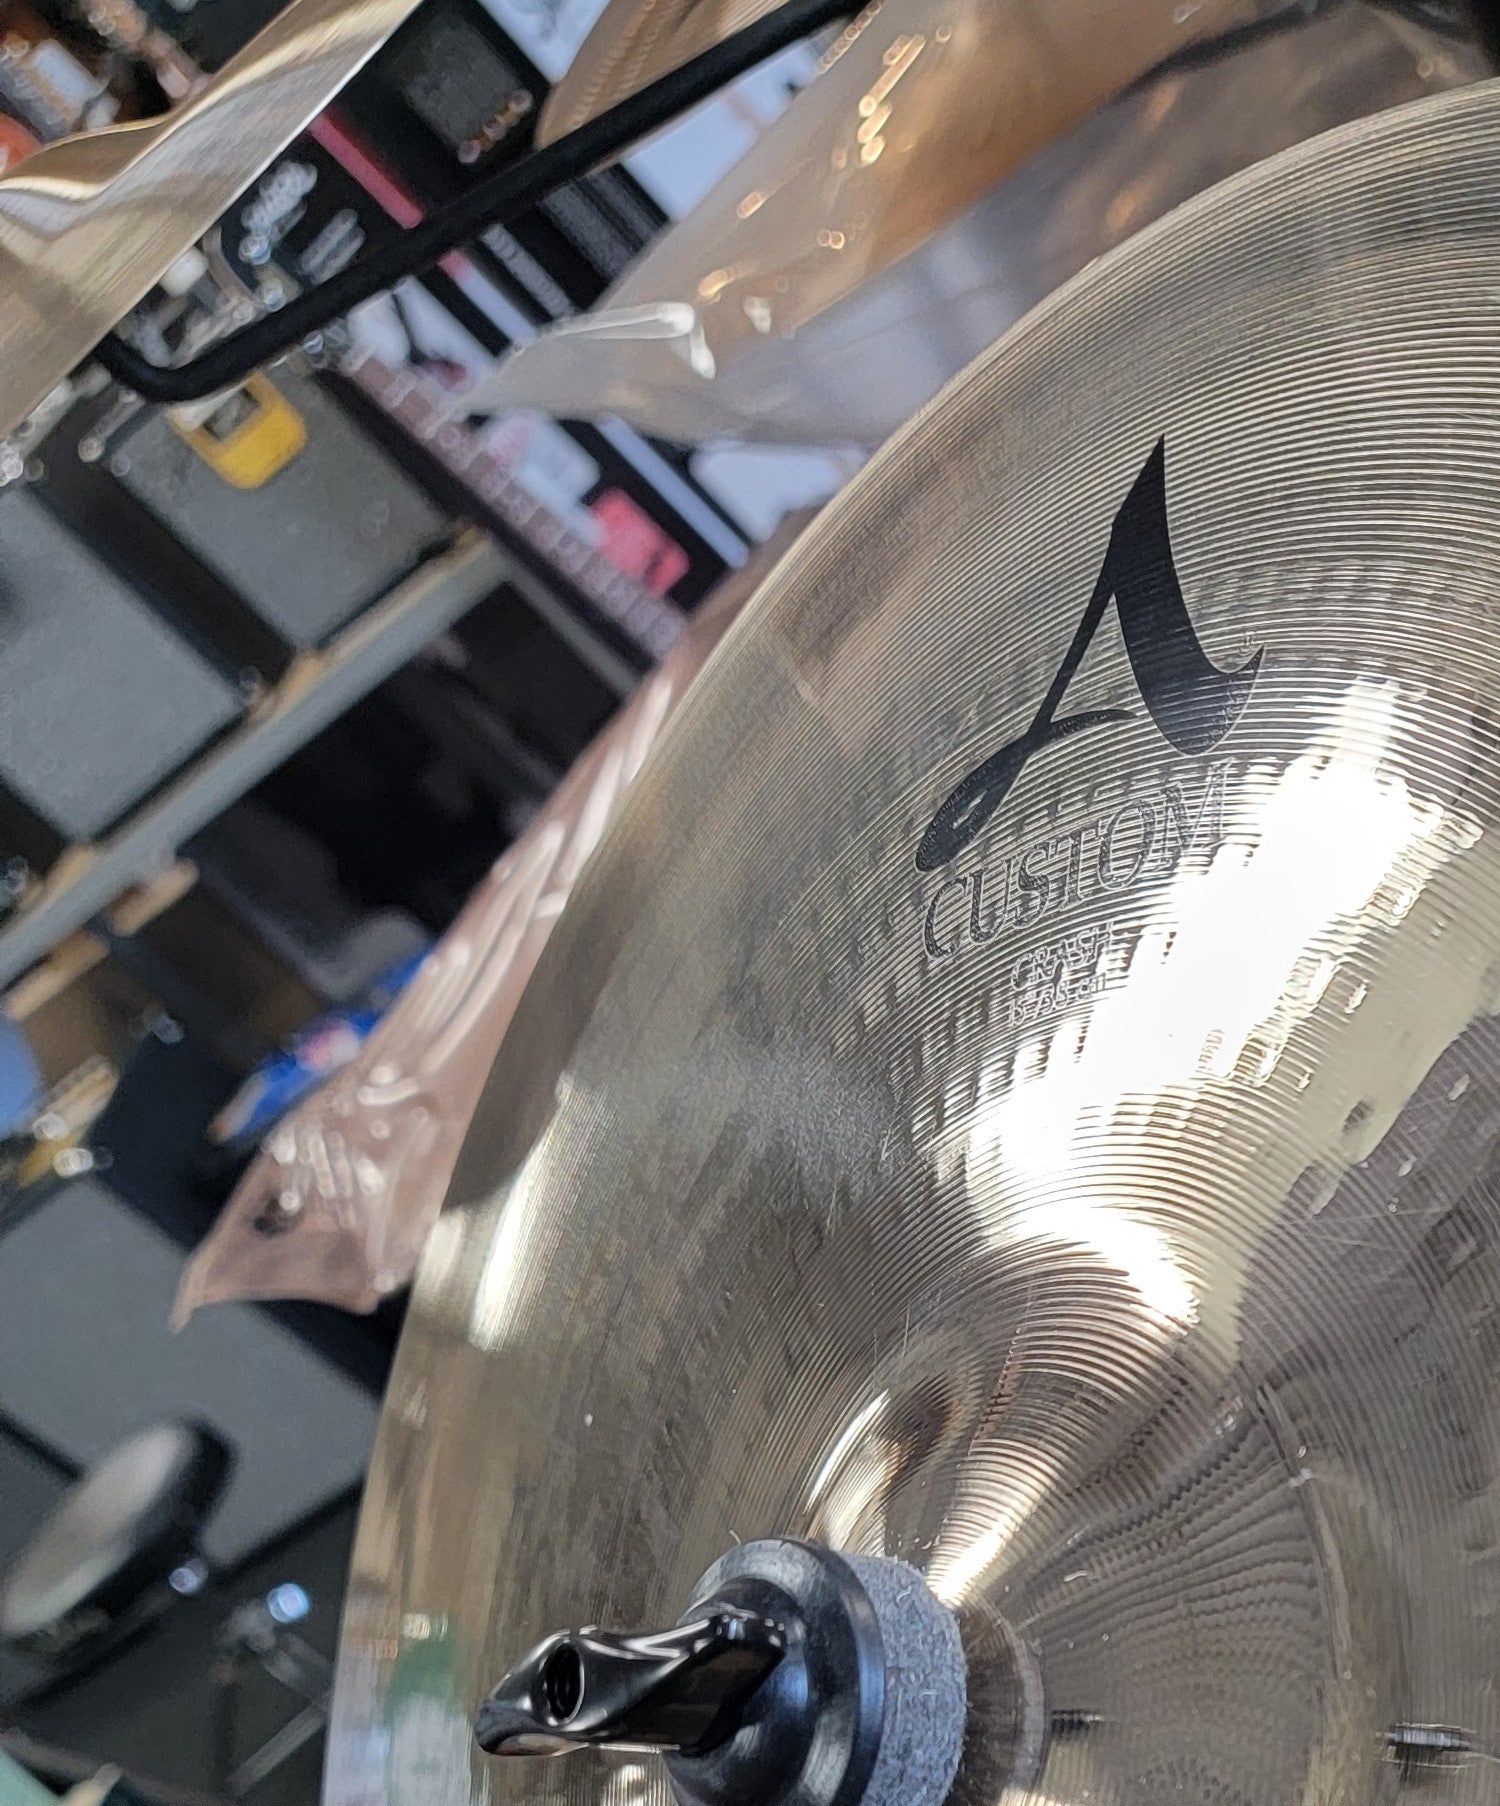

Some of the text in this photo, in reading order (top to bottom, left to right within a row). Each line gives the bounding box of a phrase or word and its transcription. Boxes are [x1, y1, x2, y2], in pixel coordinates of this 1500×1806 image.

[916, 434, 1265, 873] A
[922, 756, 1234, 960] CUSTOM
[1010, 921, 1115, 991] CRASH
